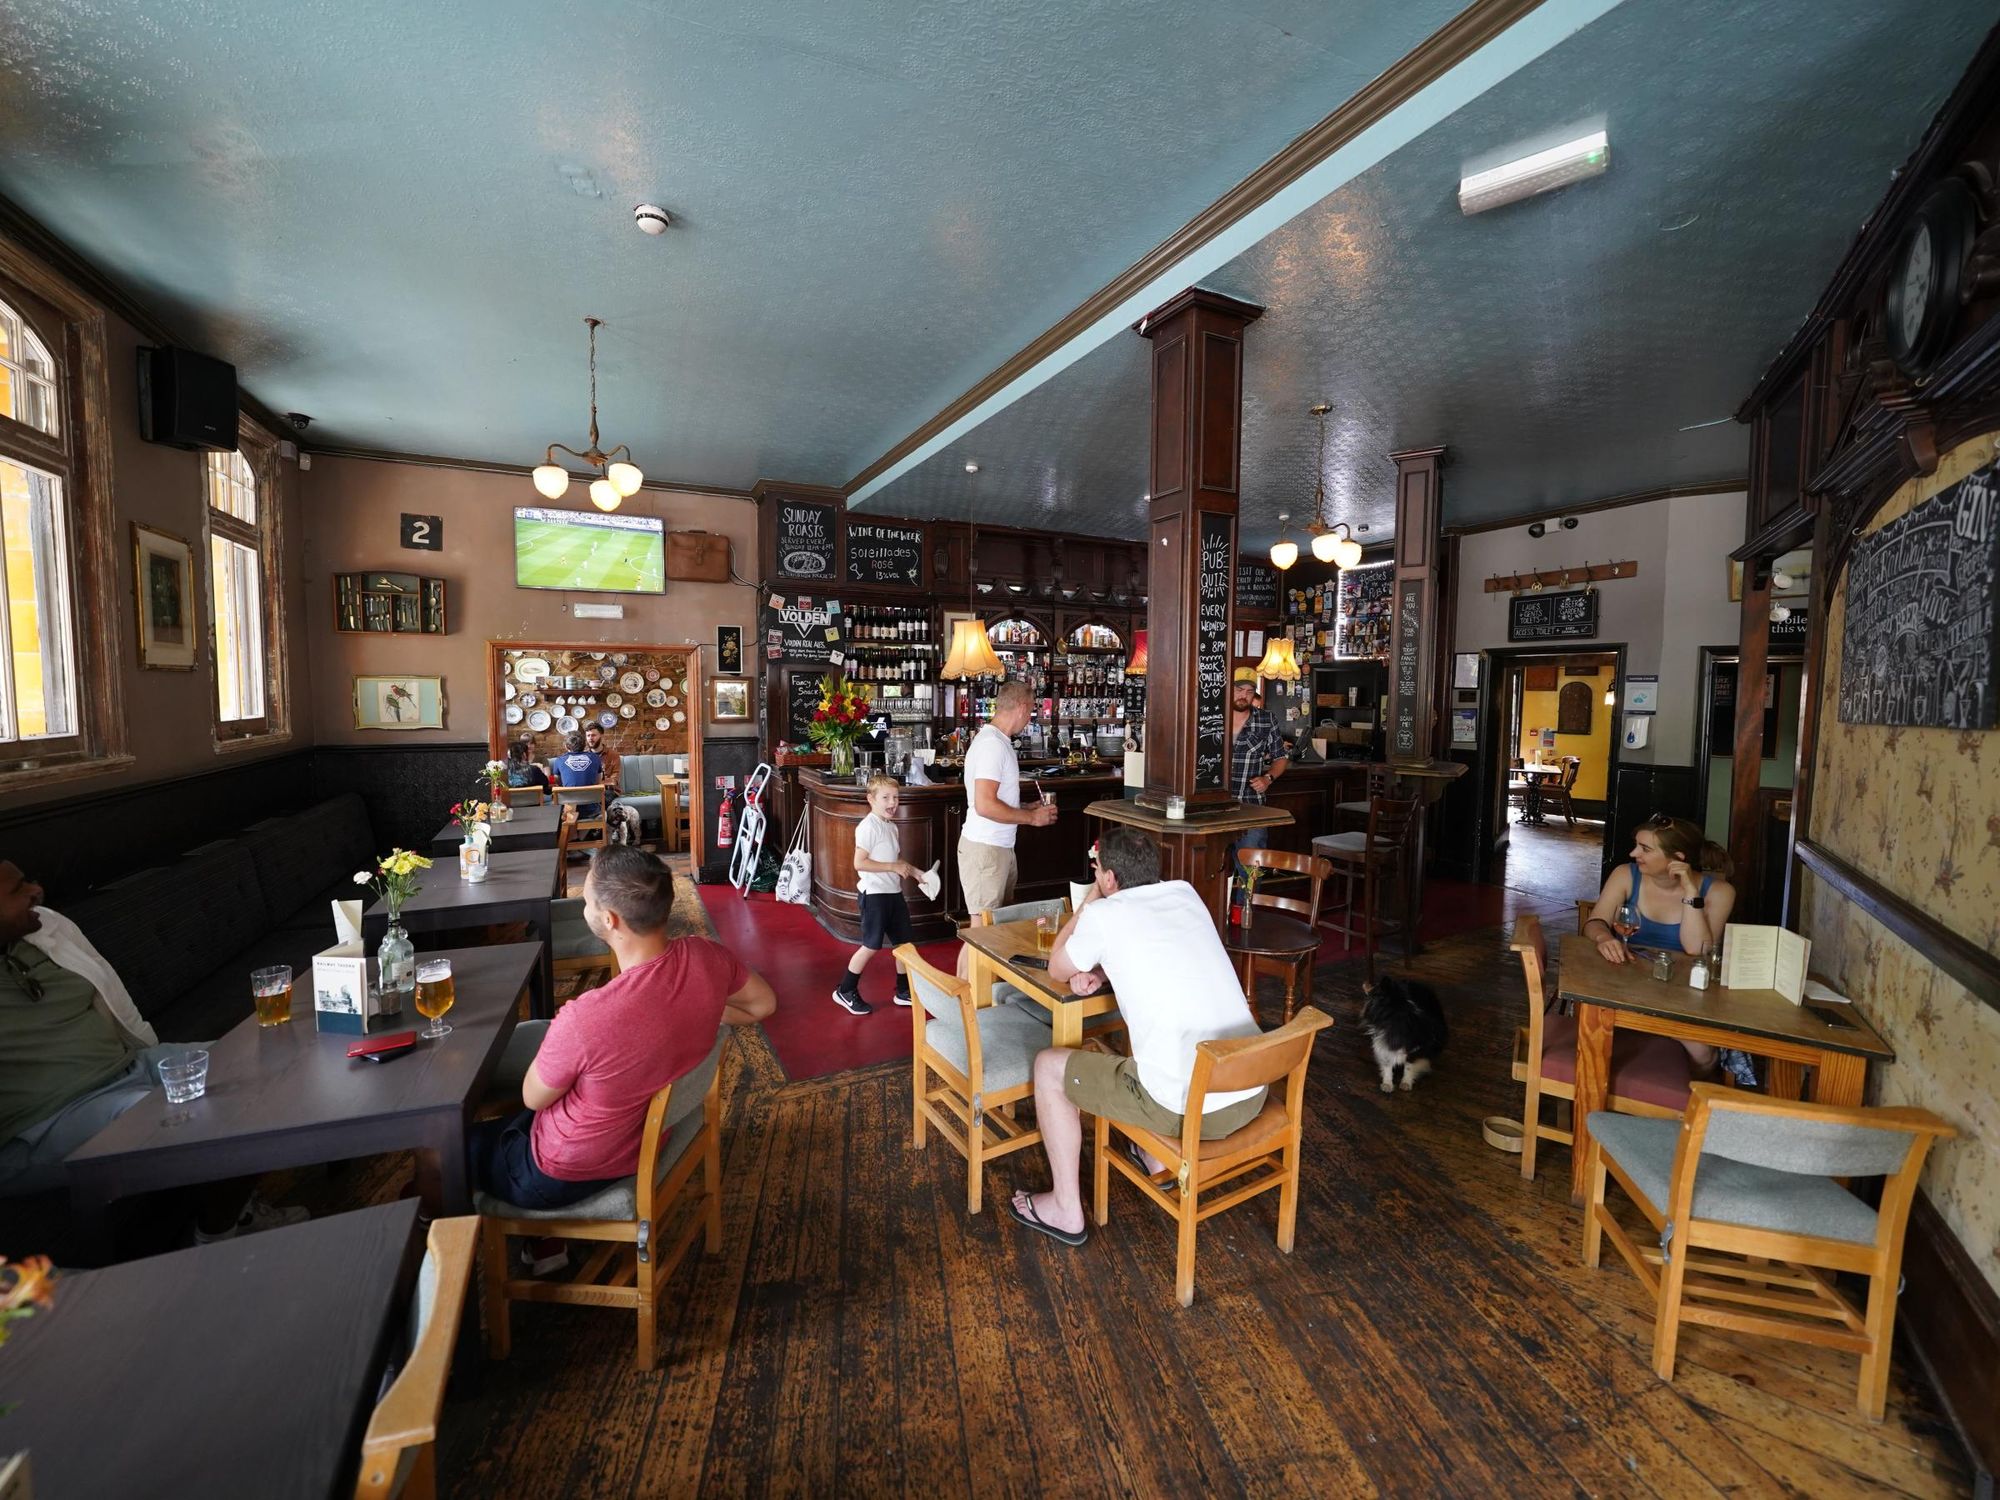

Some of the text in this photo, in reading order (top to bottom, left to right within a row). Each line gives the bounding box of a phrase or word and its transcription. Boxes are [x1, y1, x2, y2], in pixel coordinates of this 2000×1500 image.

[782, 507, 822, 524] SUNDAY
[1956, 484, 1997, 542] GIN
[412, 521, 430, 544] 2
[788, 524, 824, 538] ROASTS
[848, 526, 921, 543] WINE OF THE WEEK
[1202, 551, 1224, 571] PUB
[1200, 572, 1224, 588] QUIZ
[781, 610, 830, 625] VOLDEN
[1200, 603, 1226, 620] EVERY
[1778, 615, 1808, 625] oile
[1771, 624, 1795, 634] this
[1212, 641, 1227, 651] 8PM
[1200, 661, 1220, 672] BOOK
[792, 675, 811, 687] Fancy
[1201, 672, 1224, 682] ONLINE
